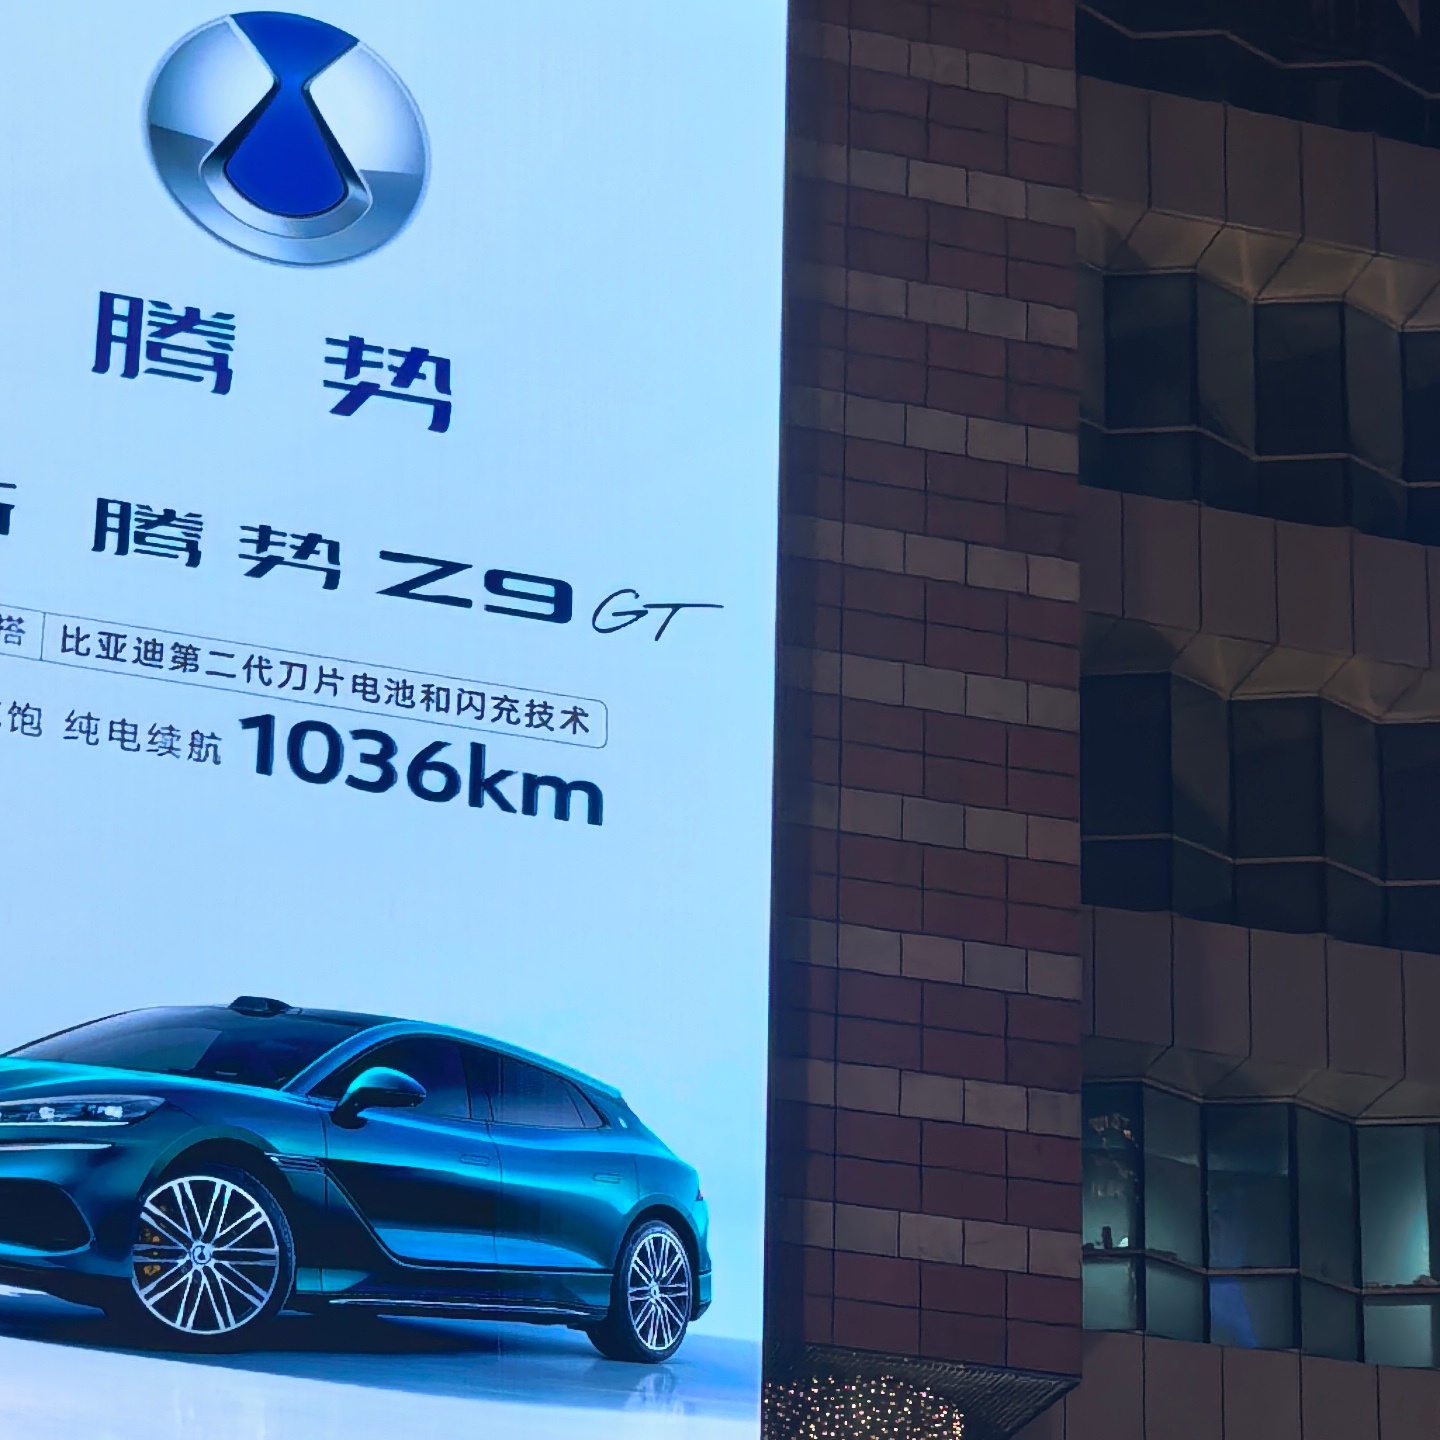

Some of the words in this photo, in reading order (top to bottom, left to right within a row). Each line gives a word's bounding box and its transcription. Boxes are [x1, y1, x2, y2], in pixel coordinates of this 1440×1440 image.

[91, 291, 452, 433] 腾势
[60, 623, 590, 736] 比亚迪第二代刀片电池和闪充技术
[62, 709, 223, 766] 纯电续航
[238, 714, 604, 827] 1036km
